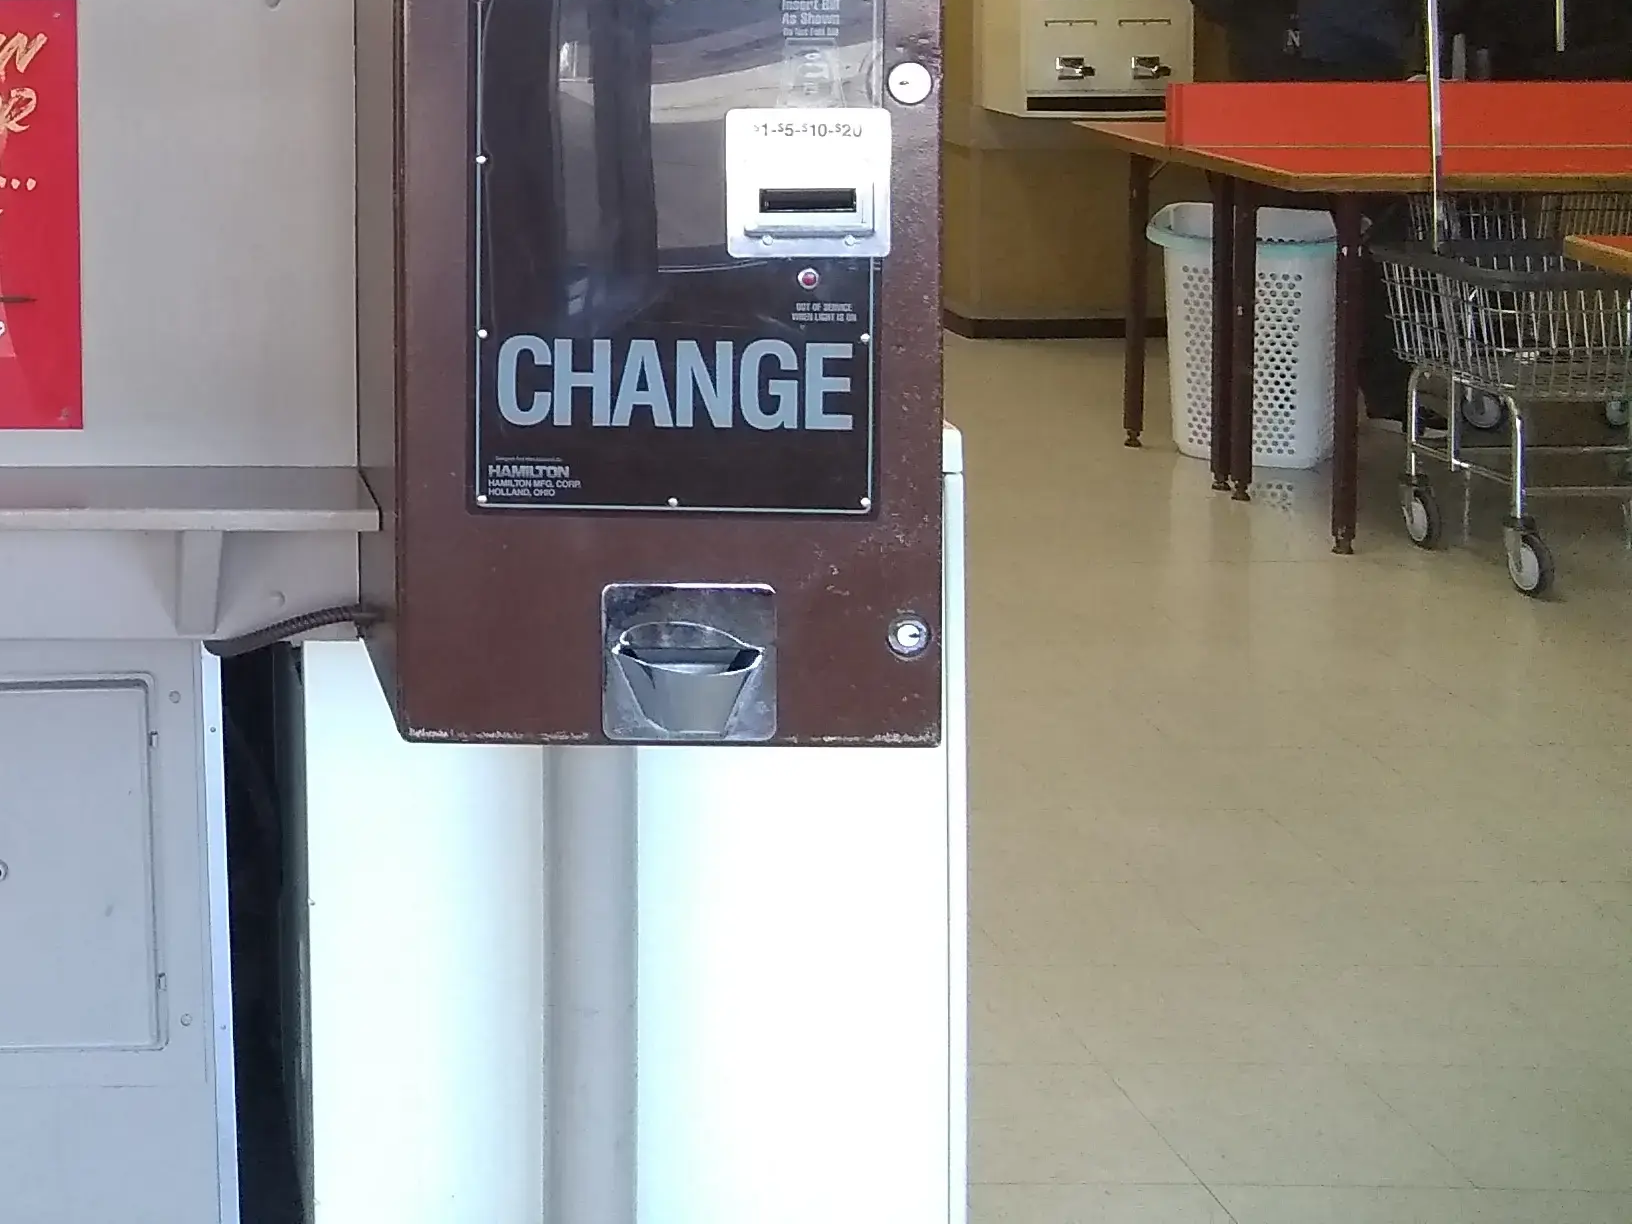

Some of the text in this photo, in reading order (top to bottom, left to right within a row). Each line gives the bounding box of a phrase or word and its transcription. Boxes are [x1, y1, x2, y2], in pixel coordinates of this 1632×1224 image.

[781, 12, 840, 25] As Shown
[497, 334, 854, 430] CHANGE
[488, 465, 570, 478] HAMILTON
[488, 479, 531, 488] HAMILTON
[556, 480, 582, 489] CORP.
[488, 488, 556, 497] HOLLAND, OHIO
